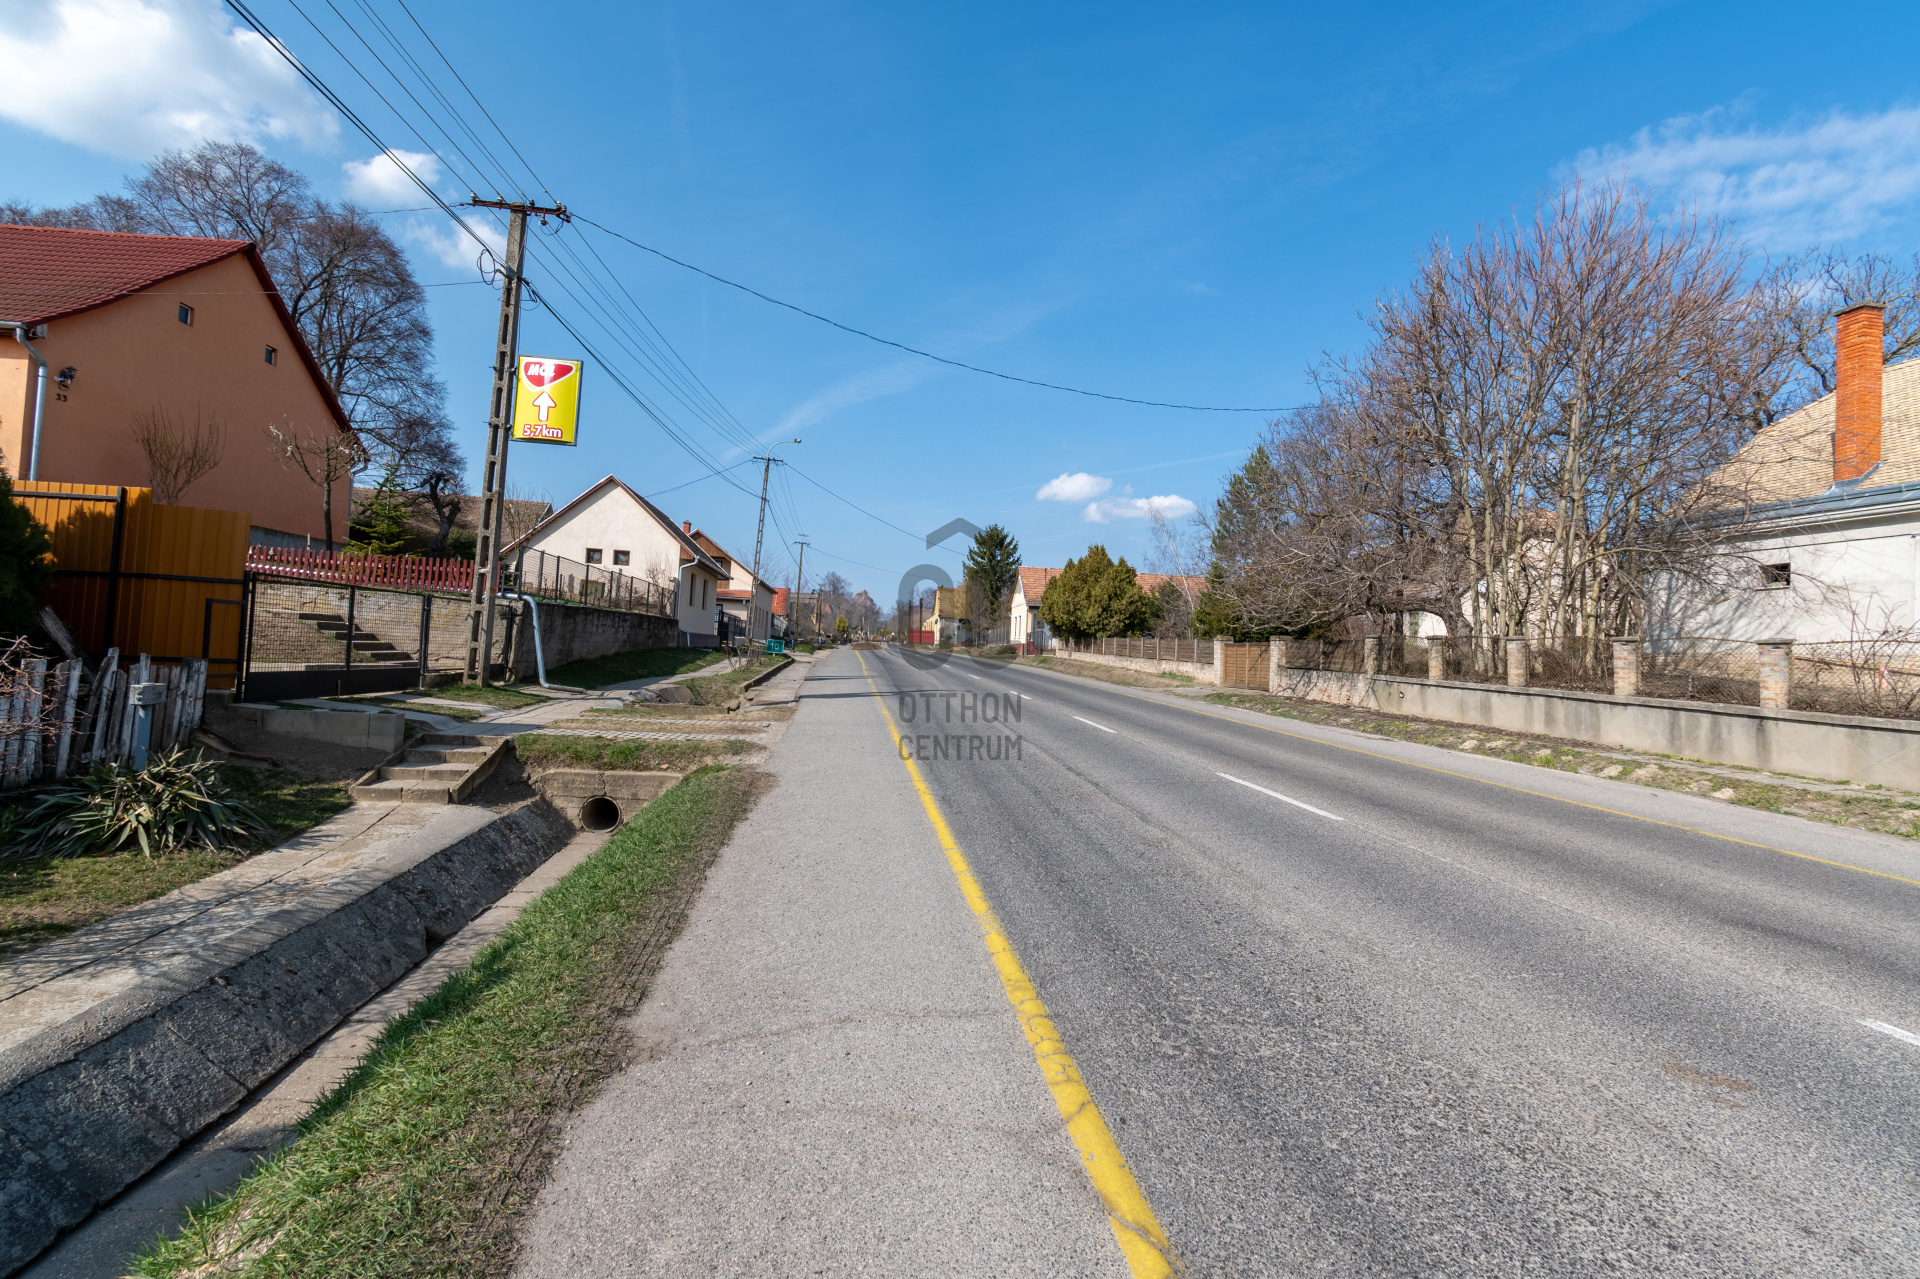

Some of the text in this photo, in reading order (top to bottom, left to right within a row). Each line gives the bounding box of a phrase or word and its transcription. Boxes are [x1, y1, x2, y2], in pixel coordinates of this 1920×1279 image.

[527, 363, 555, 376] MOL
[56, 393, 68, 402] 33
[523, 424, 562, 438] 5,7km
[770, 642, 780, 650] 10
